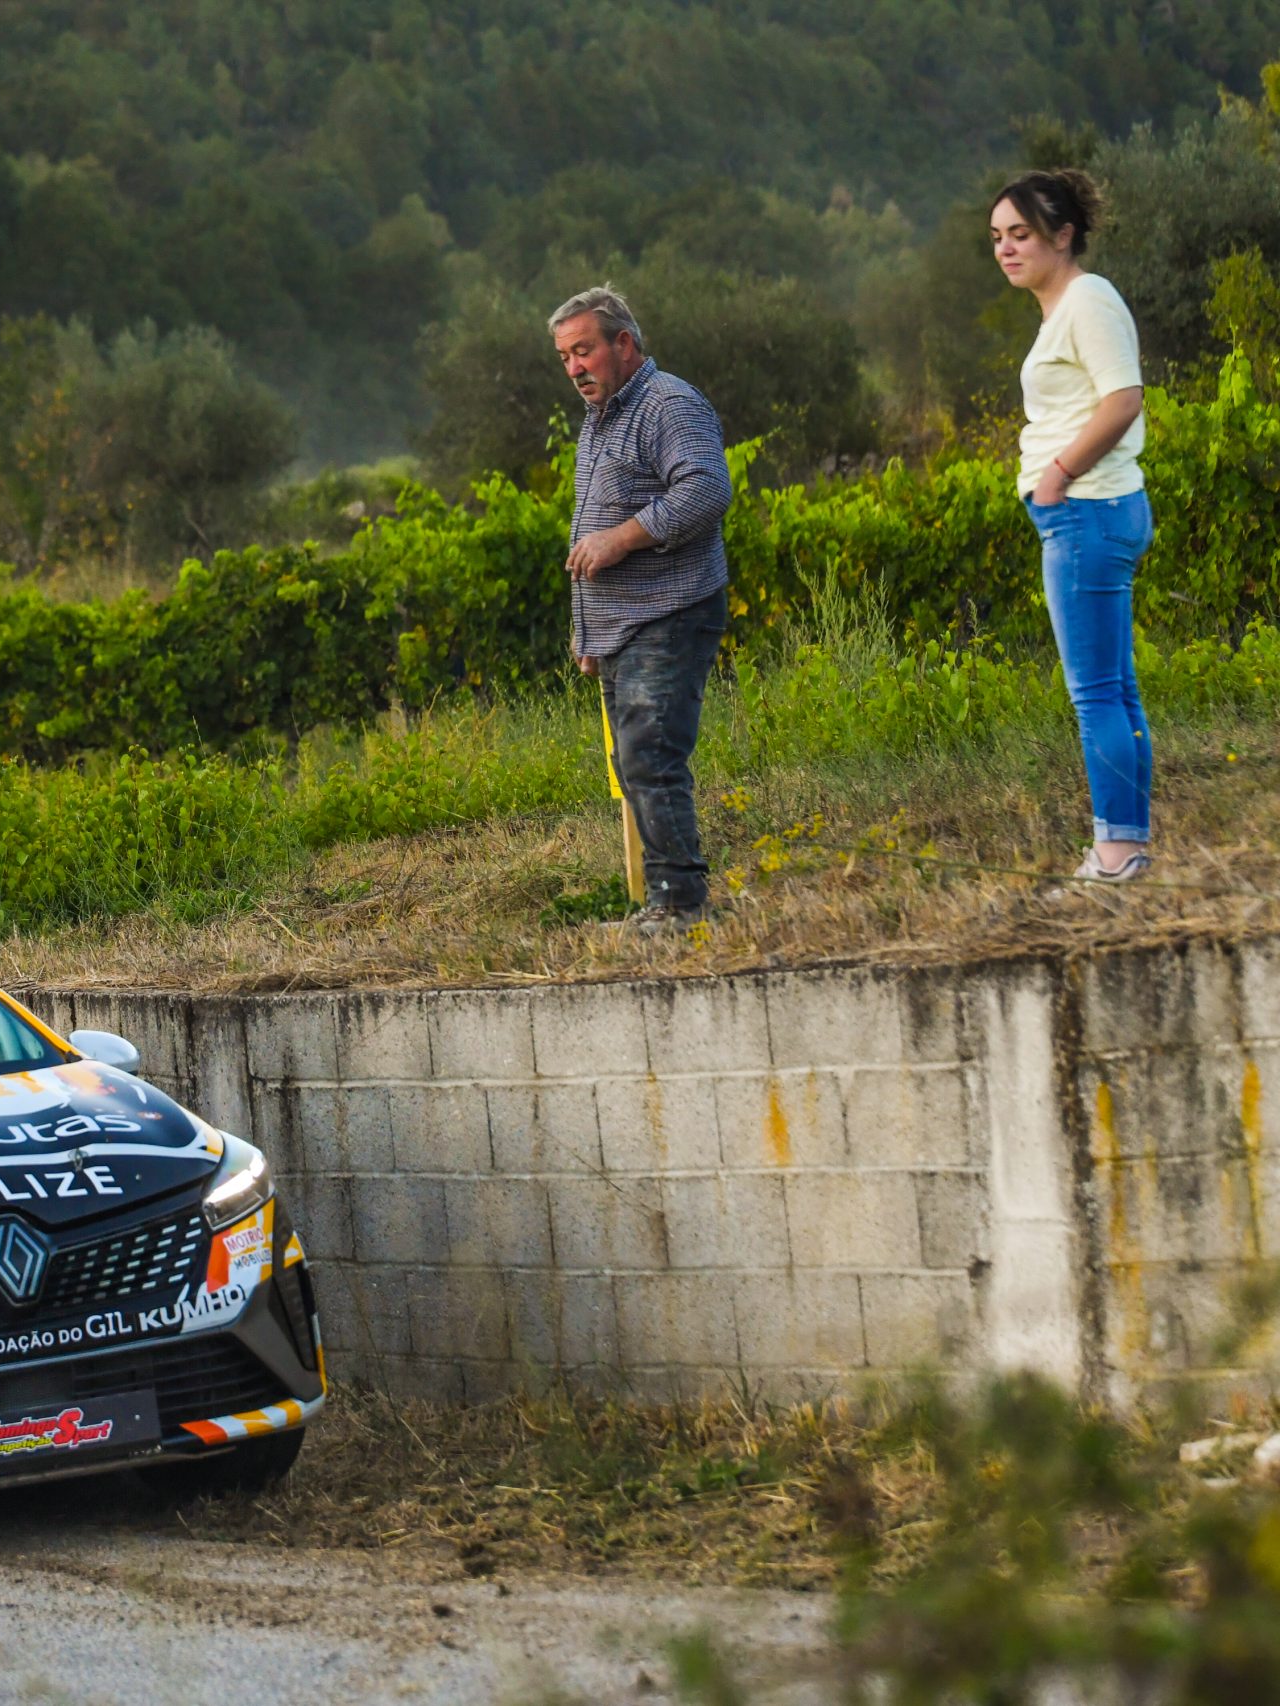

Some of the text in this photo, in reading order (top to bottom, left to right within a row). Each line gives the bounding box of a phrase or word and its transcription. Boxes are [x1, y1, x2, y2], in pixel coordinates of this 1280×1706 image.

[225, 1227, 264, 1252] MOTRIO
[139, 1284, 247, 1332] KUMHO
[59, 1327, 83, 1345] DO
[85, 1312, 133, 1340] GIL
